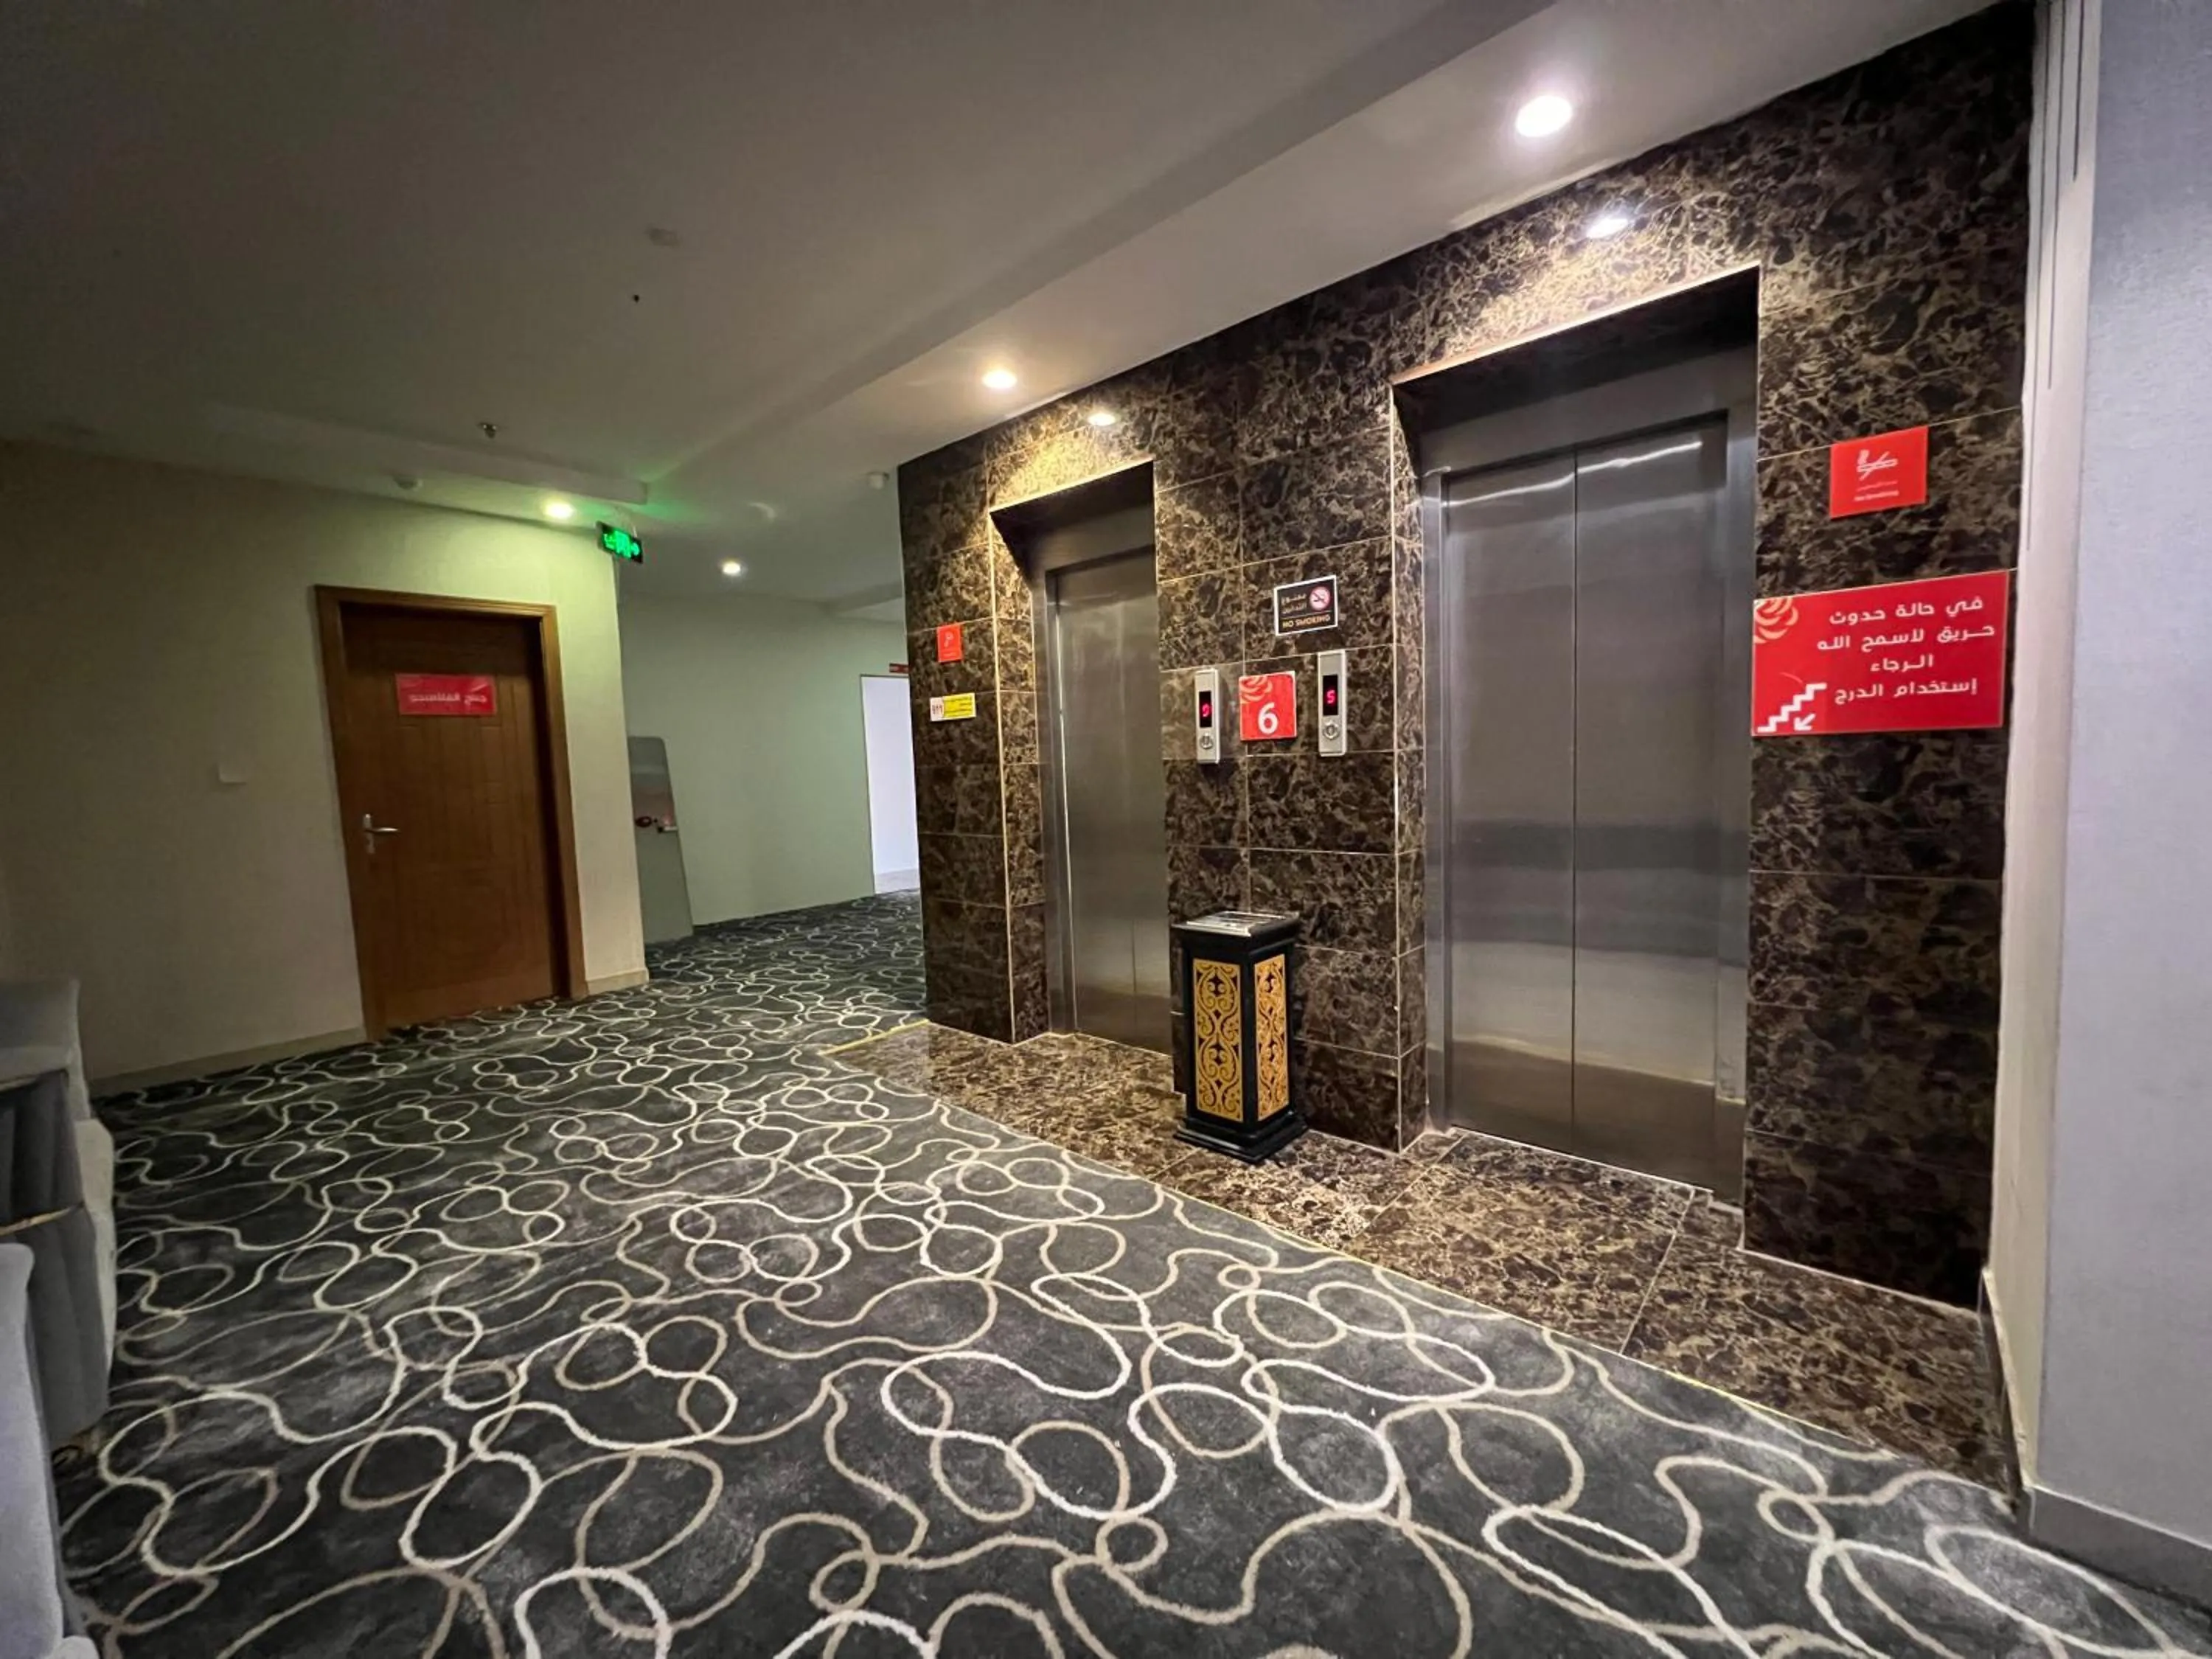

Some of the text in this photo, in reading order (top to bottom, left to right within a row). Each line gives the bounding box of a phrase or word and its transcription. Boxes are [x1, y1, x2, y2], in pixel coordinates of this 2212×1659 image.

[1829, 595, 1983, 626] في حالة حدوث
[1282, 619, 1294, 628] NO
[1816, 635, 1851, 651] الله
[1936, 625, 1995, 644] حريق
[1869, 653, 1935, 673] الرجاء
[1834, 677, 1978, 705] إستخدام الدرج
[1257, 702, 1279, 734] 6
